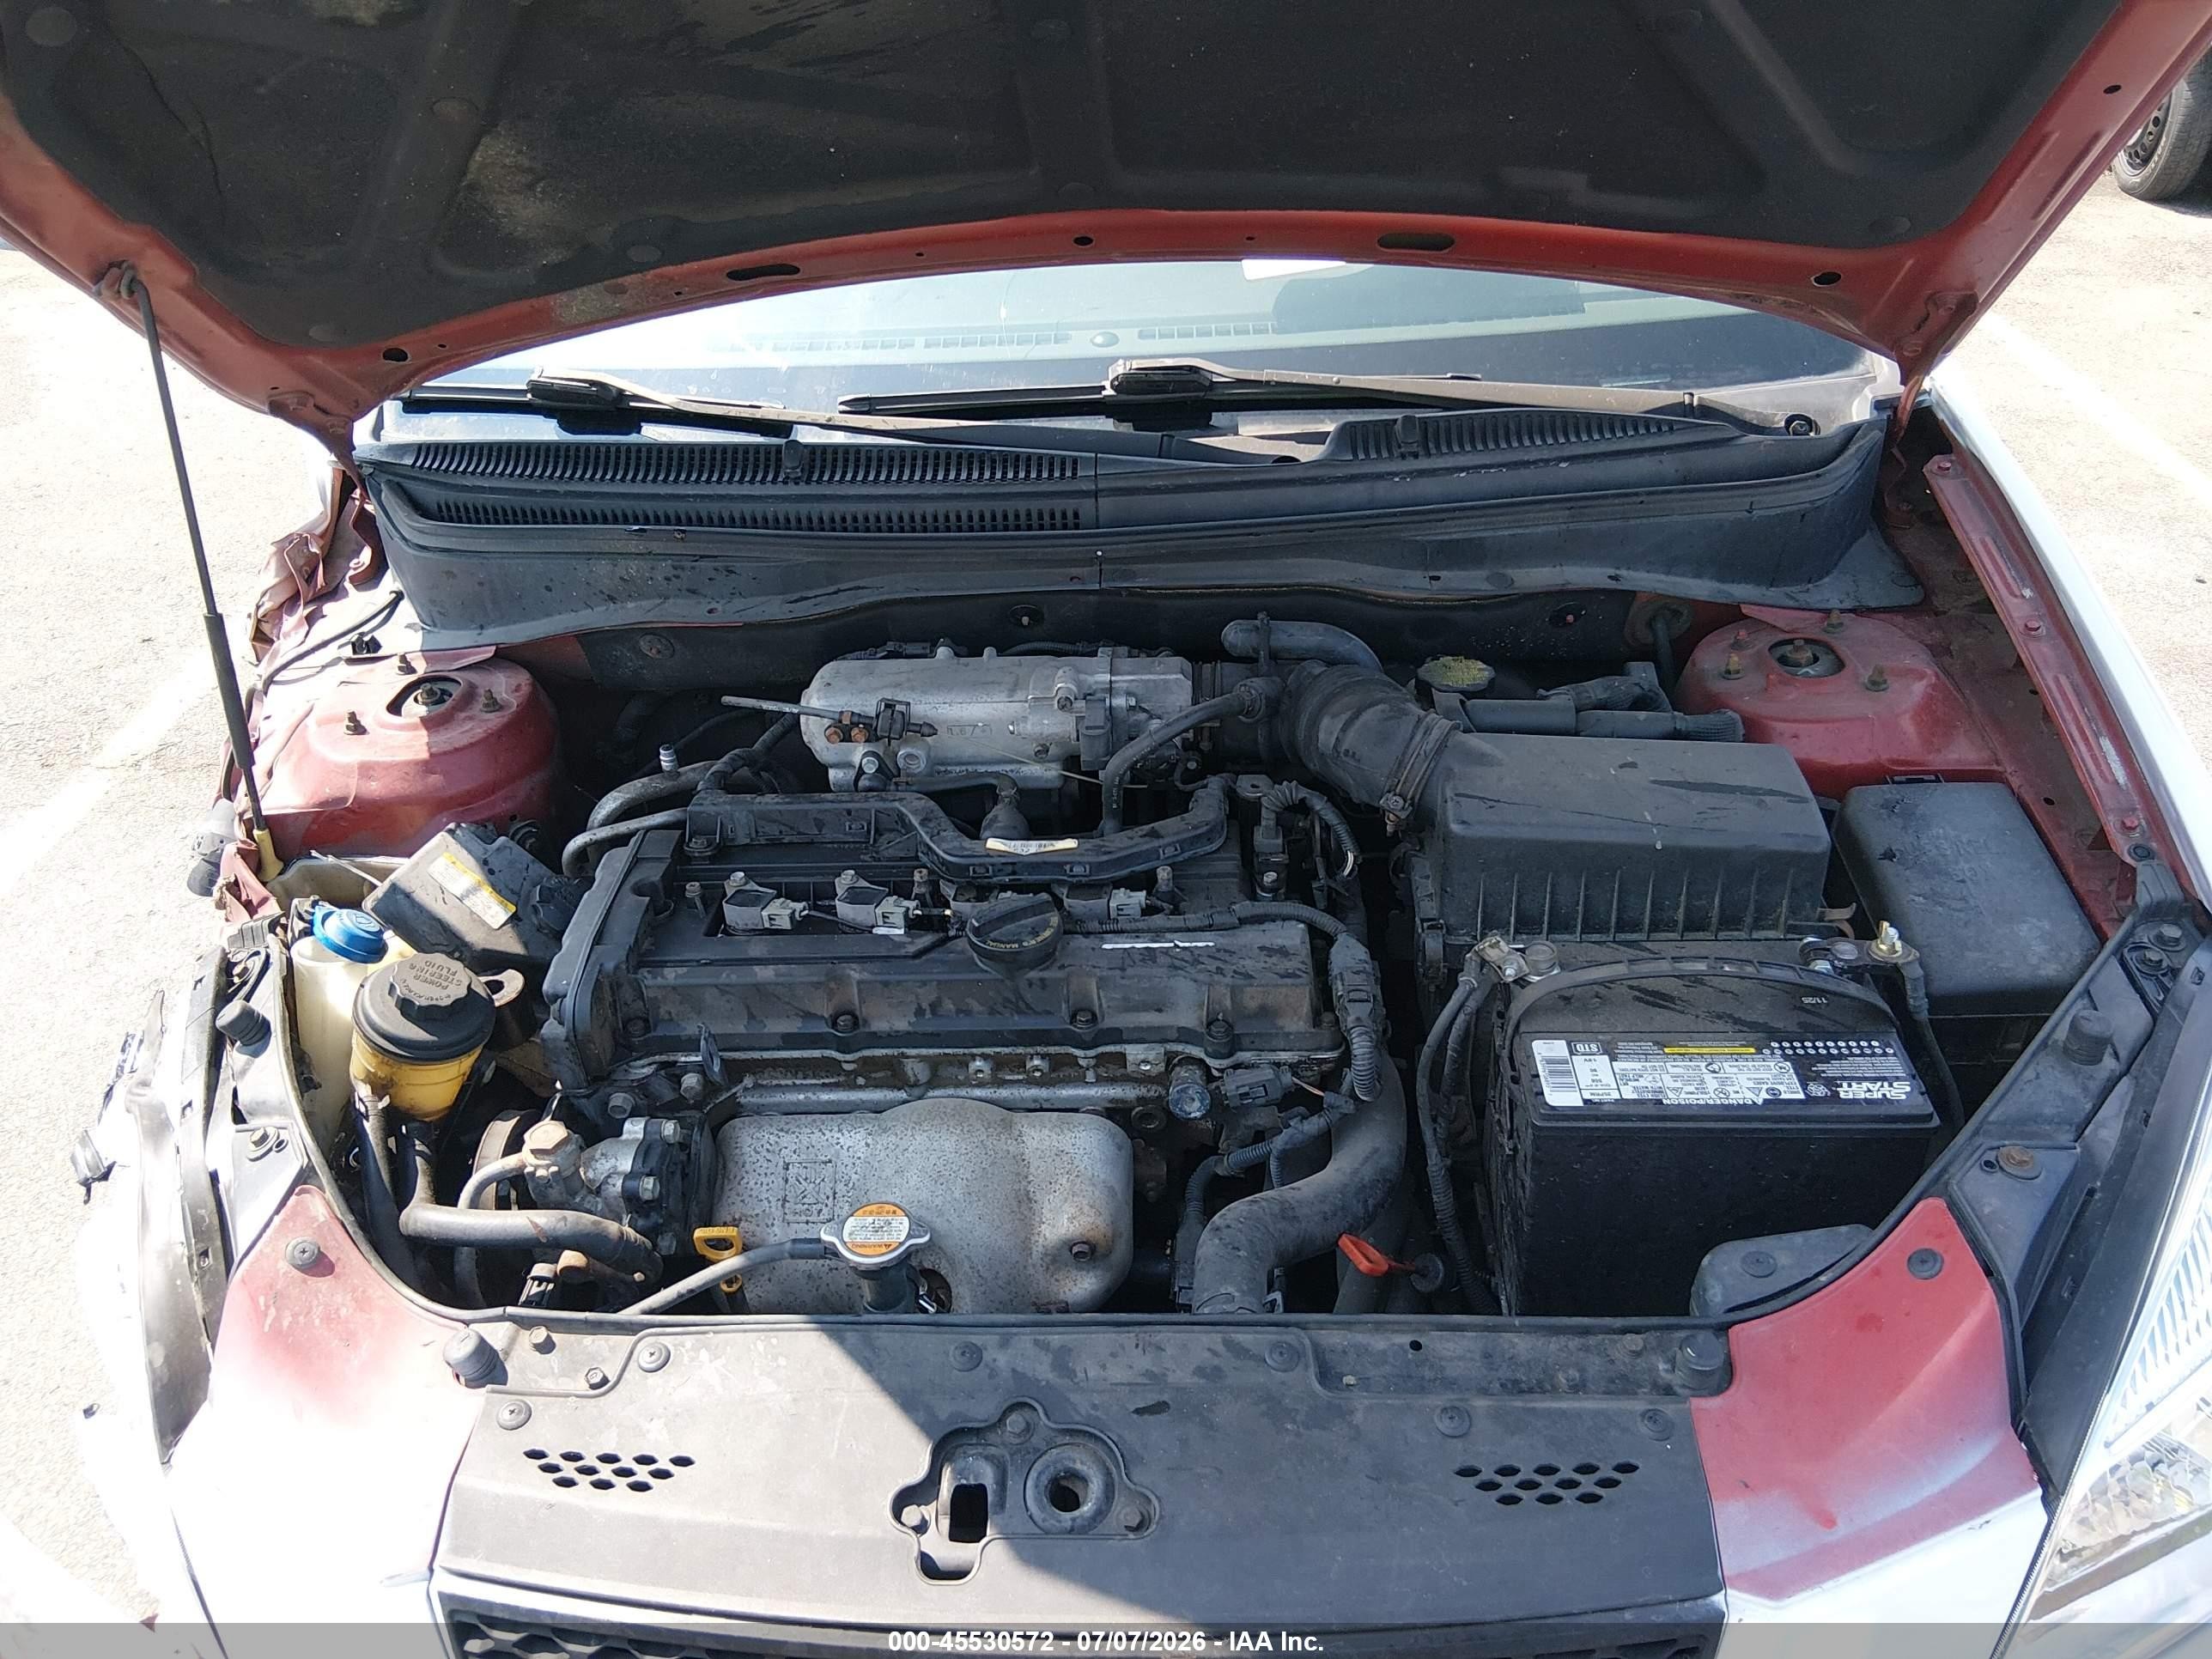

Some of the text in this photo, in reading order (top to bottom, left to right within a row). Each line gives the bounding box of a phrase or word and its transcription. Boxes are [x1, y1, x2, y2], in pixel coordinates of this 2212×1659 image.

[985, 939, 1019, 949] MANUAL
[424, 961, 458, 976] FLUID
[412, 974, 449, 990] POWER
[1577, 1043, 1599, 1052] STD
[1836, 1081, 1911, 1092] START
[1838, 1091, 1906, 1100] SUPER
